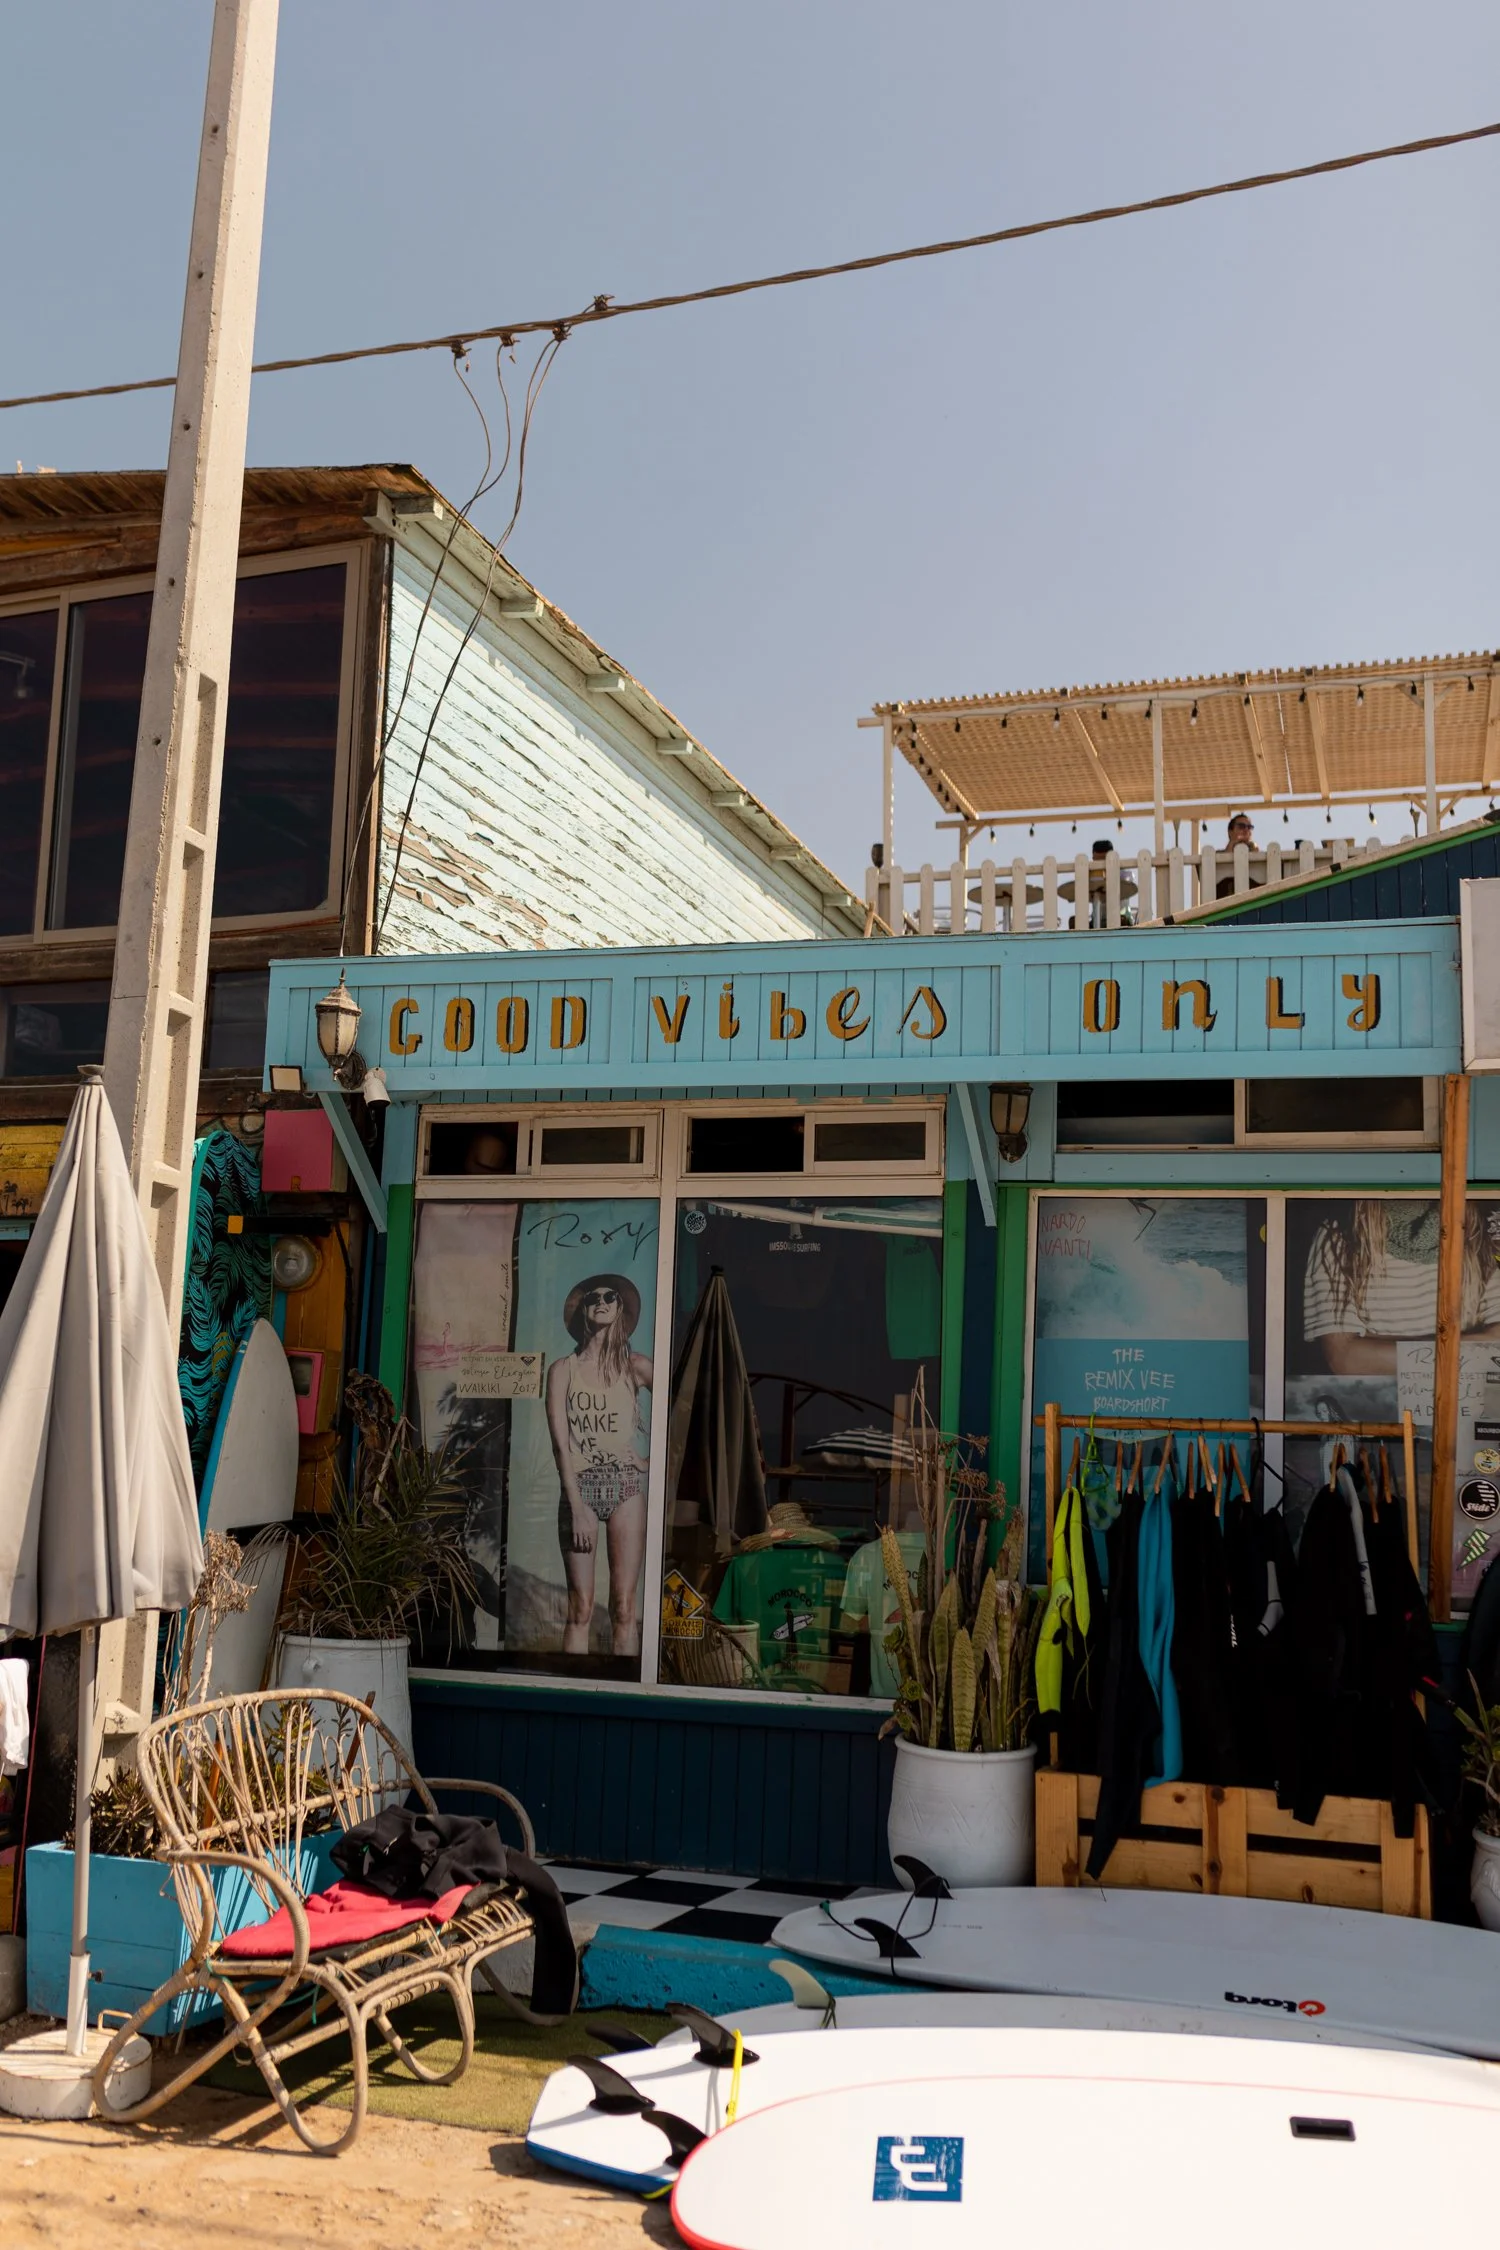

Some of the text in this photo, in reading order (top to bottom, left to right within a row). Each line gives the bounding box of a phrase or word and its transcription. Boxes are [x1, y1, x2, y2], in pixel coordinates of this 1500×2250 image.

[388, 994, 588, 1056] GOOD
[1112, 1347, 1145, 1364] THE
[459, 1381, 538, 1395] WAIKIKI 2017
[1085, 1368, 1176, 1391] REMIX VEE
[568, 1391, 607, 1411] YOU
[1093, 1395, 1170, 1413] BOARDSHORT
[568, 1412, 619, 1434] MAKE
[767, 1588, 813, 1608] MOROCCO
[1224, 1990, 1298, 2014] torq
